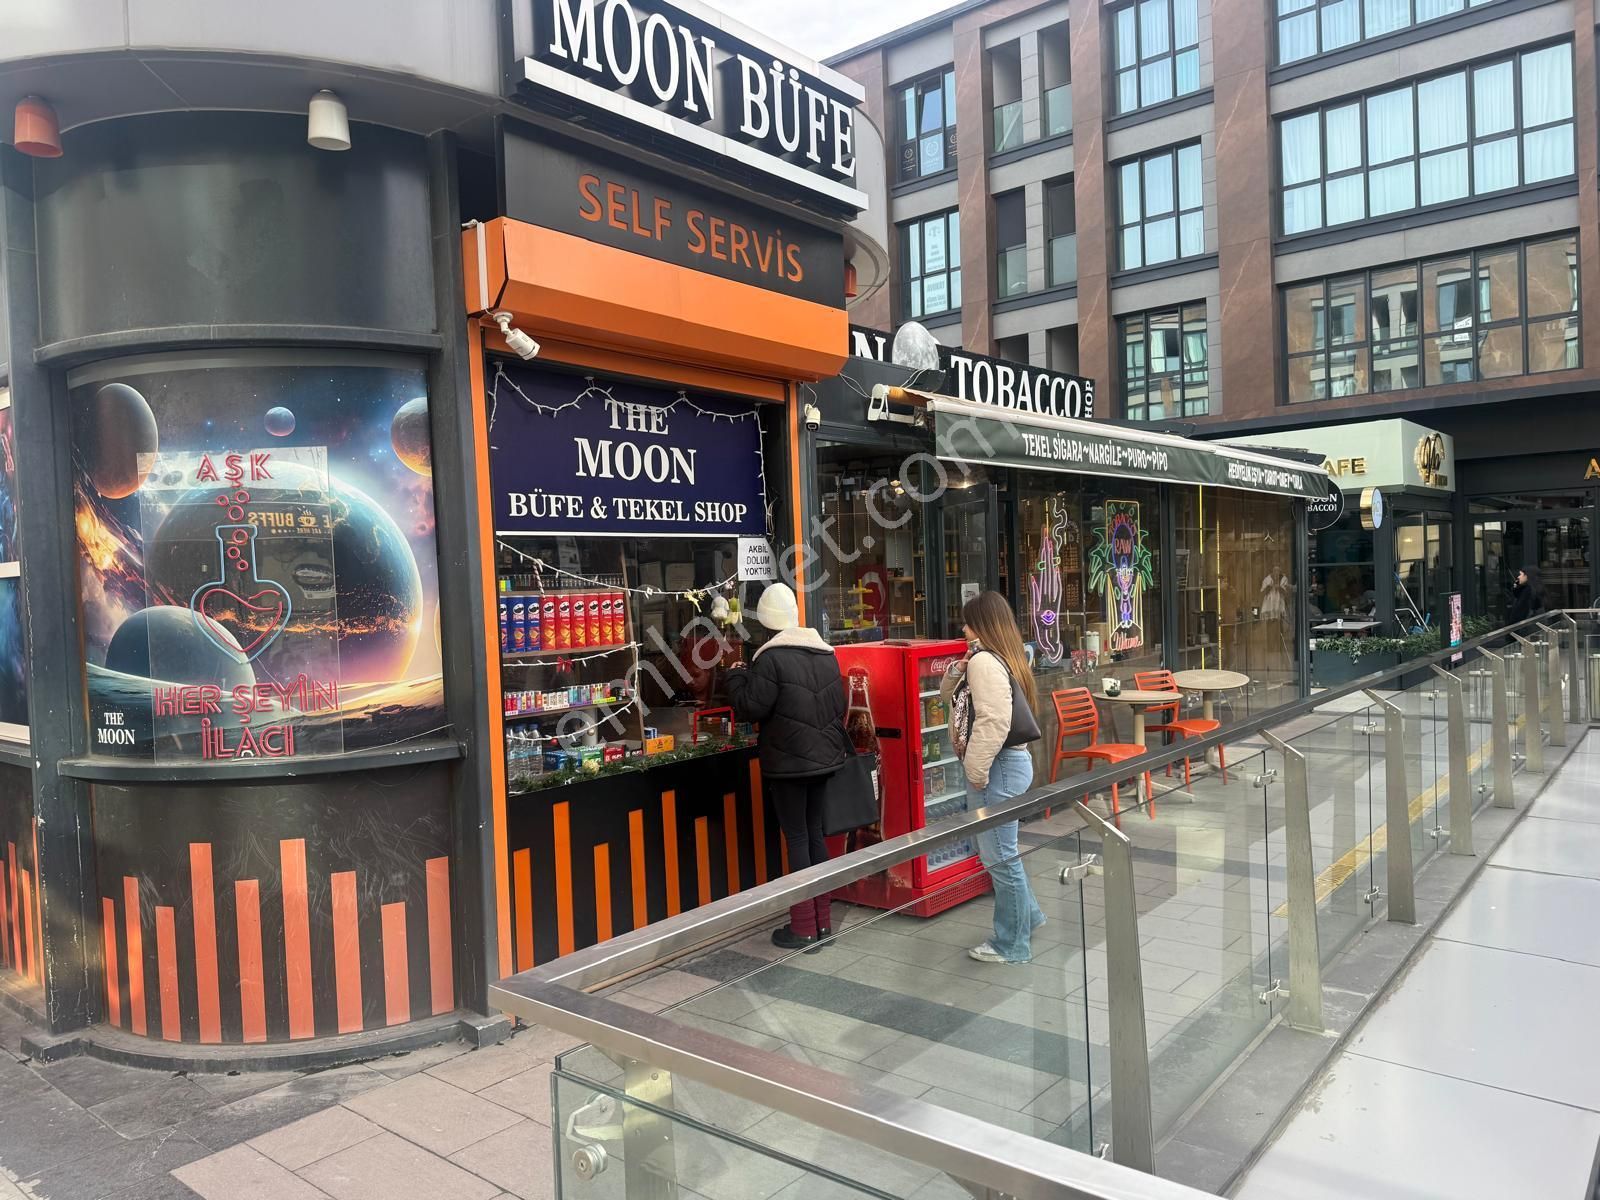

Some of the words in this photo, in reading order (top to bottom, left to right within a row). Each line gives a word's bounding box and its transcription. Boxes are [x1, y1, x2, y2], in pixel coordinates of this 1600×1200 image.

[549, 0, 715, 121] MOON
[737, 53, 856, 178] BÜFE
[577, 173, 672, 241] SELF
[686, 210, 804, 283] SERVİS
[950, 354, 1082, 418] TOBACCO
[1084, 380, 1094, 418] HOP
[604, 398, 669, 435] THE
[574, 437, 697, 486] MOON
[1021, 433, 1052, 459] TEKEL
[196, 453, 275, 488] AŞK
[1323, 457, 1366, 477] AFE
[508, 488, 584, 519] BÜFE
[590, 496, 608, 519] &
[613, 497, 690, 522] TEKEL
[695, 501, 748, 524] SHOP
[746, 555, 770, 565] DOLUM
[748, 543, 769, 553] AKBİL
[744, 567, 772, 576] YOKTUR
[155, 684, 222, 717] HER
[231, 672, 340, 724] ŞEYİN
[97, 727, 136, 745] MOON
[103, 712, 125, 726] THE
[201, 717, 296, 760] İLACI
